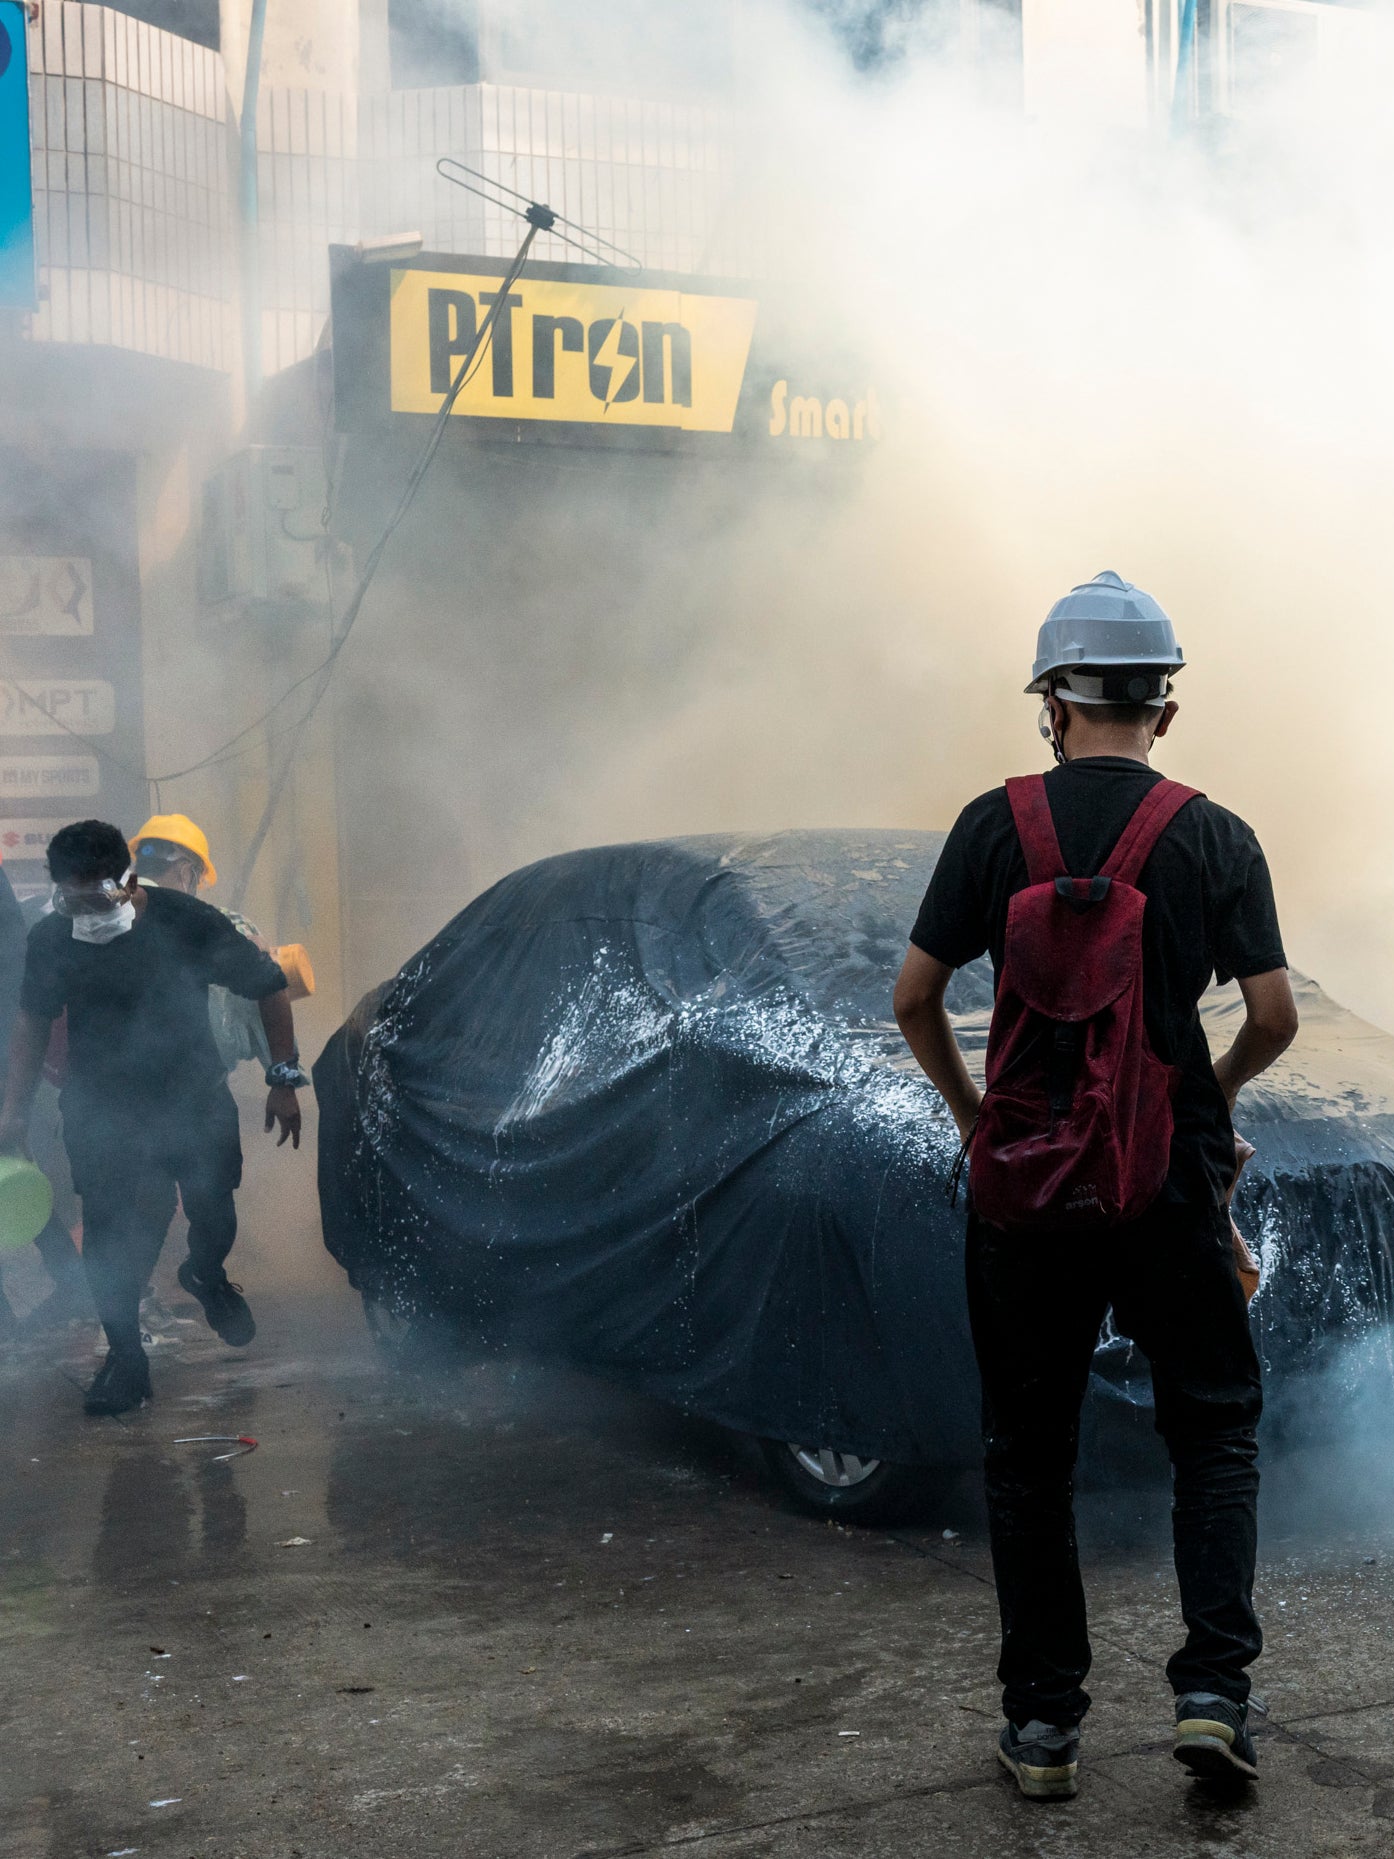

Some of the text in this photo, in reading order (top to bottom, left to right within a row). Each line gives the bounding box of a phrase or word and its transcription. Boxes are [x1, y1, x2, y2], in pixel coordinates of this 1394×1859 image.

[428, 287, 692, 410] PTron
[768, 379, 882, 440] Smart
[18, 688, 97, 716] MPT
